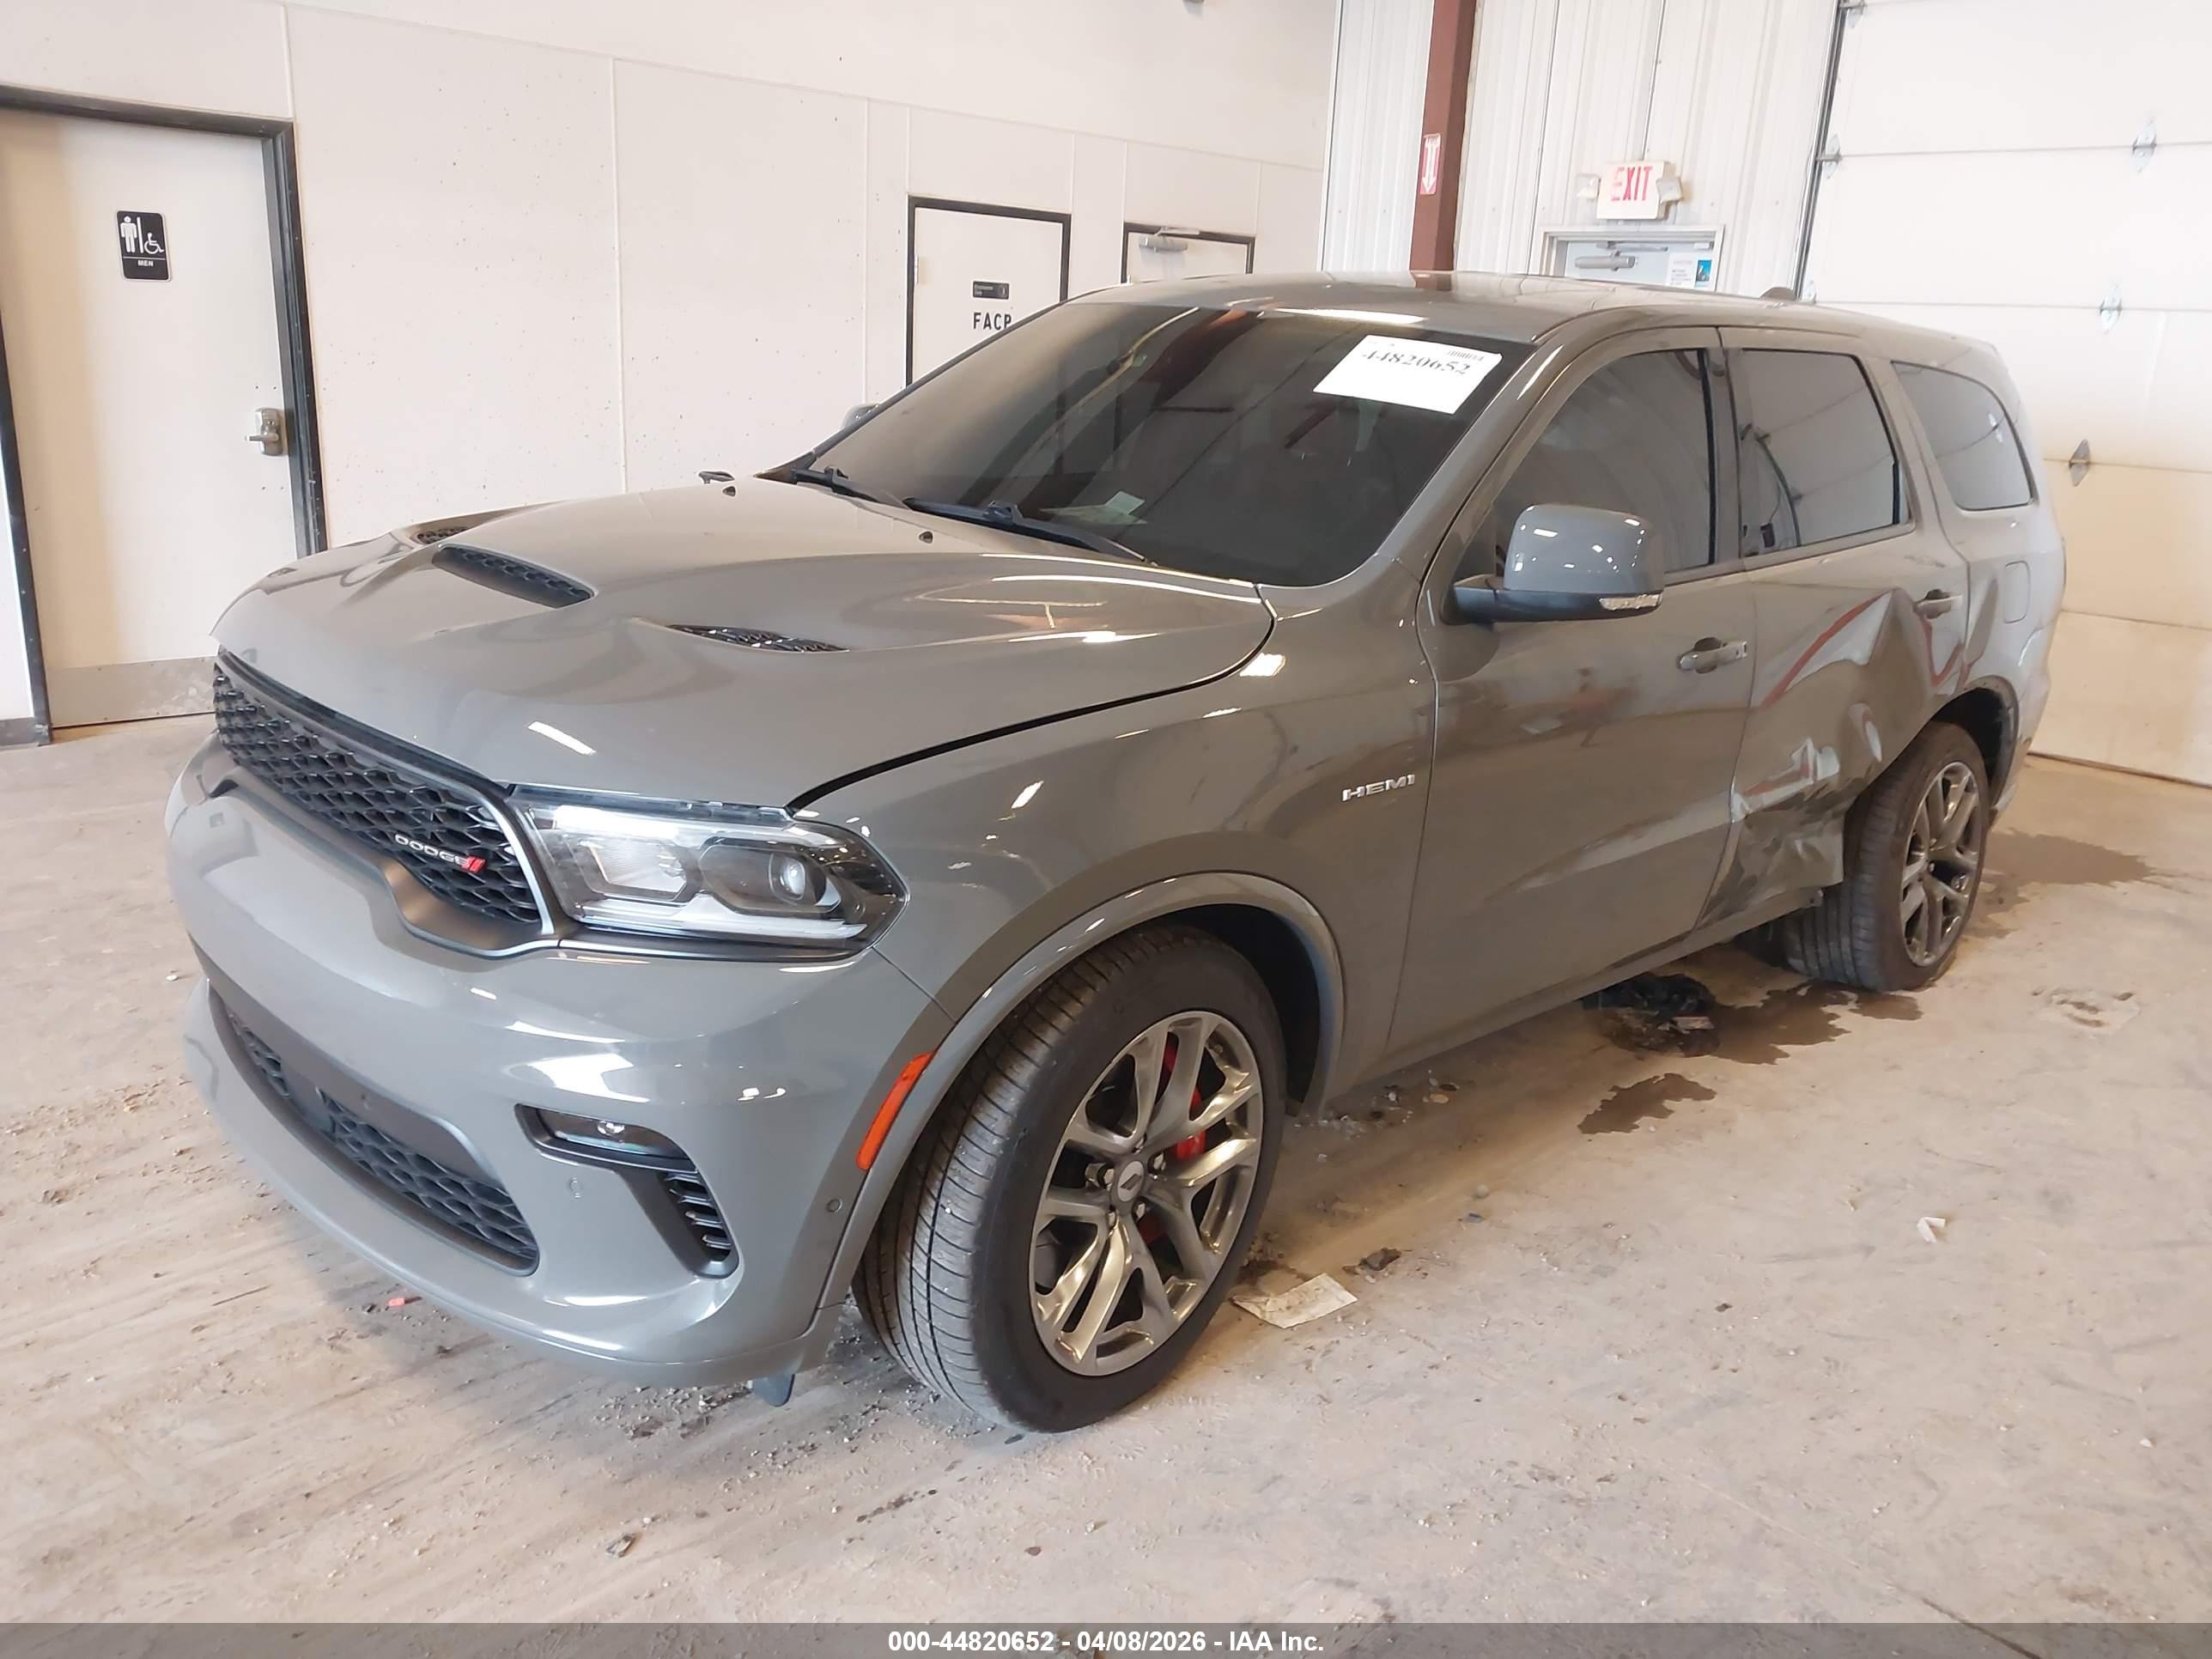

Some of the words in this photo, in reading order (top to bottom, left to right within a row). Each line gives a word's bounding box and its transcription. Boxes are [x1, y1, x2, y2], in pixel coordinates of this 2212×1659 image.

[1611, 166, 1653, 201] EXIT
[1342, 775, 1415, 801] HEMI
[395, 834, 470, 868] DODGE
